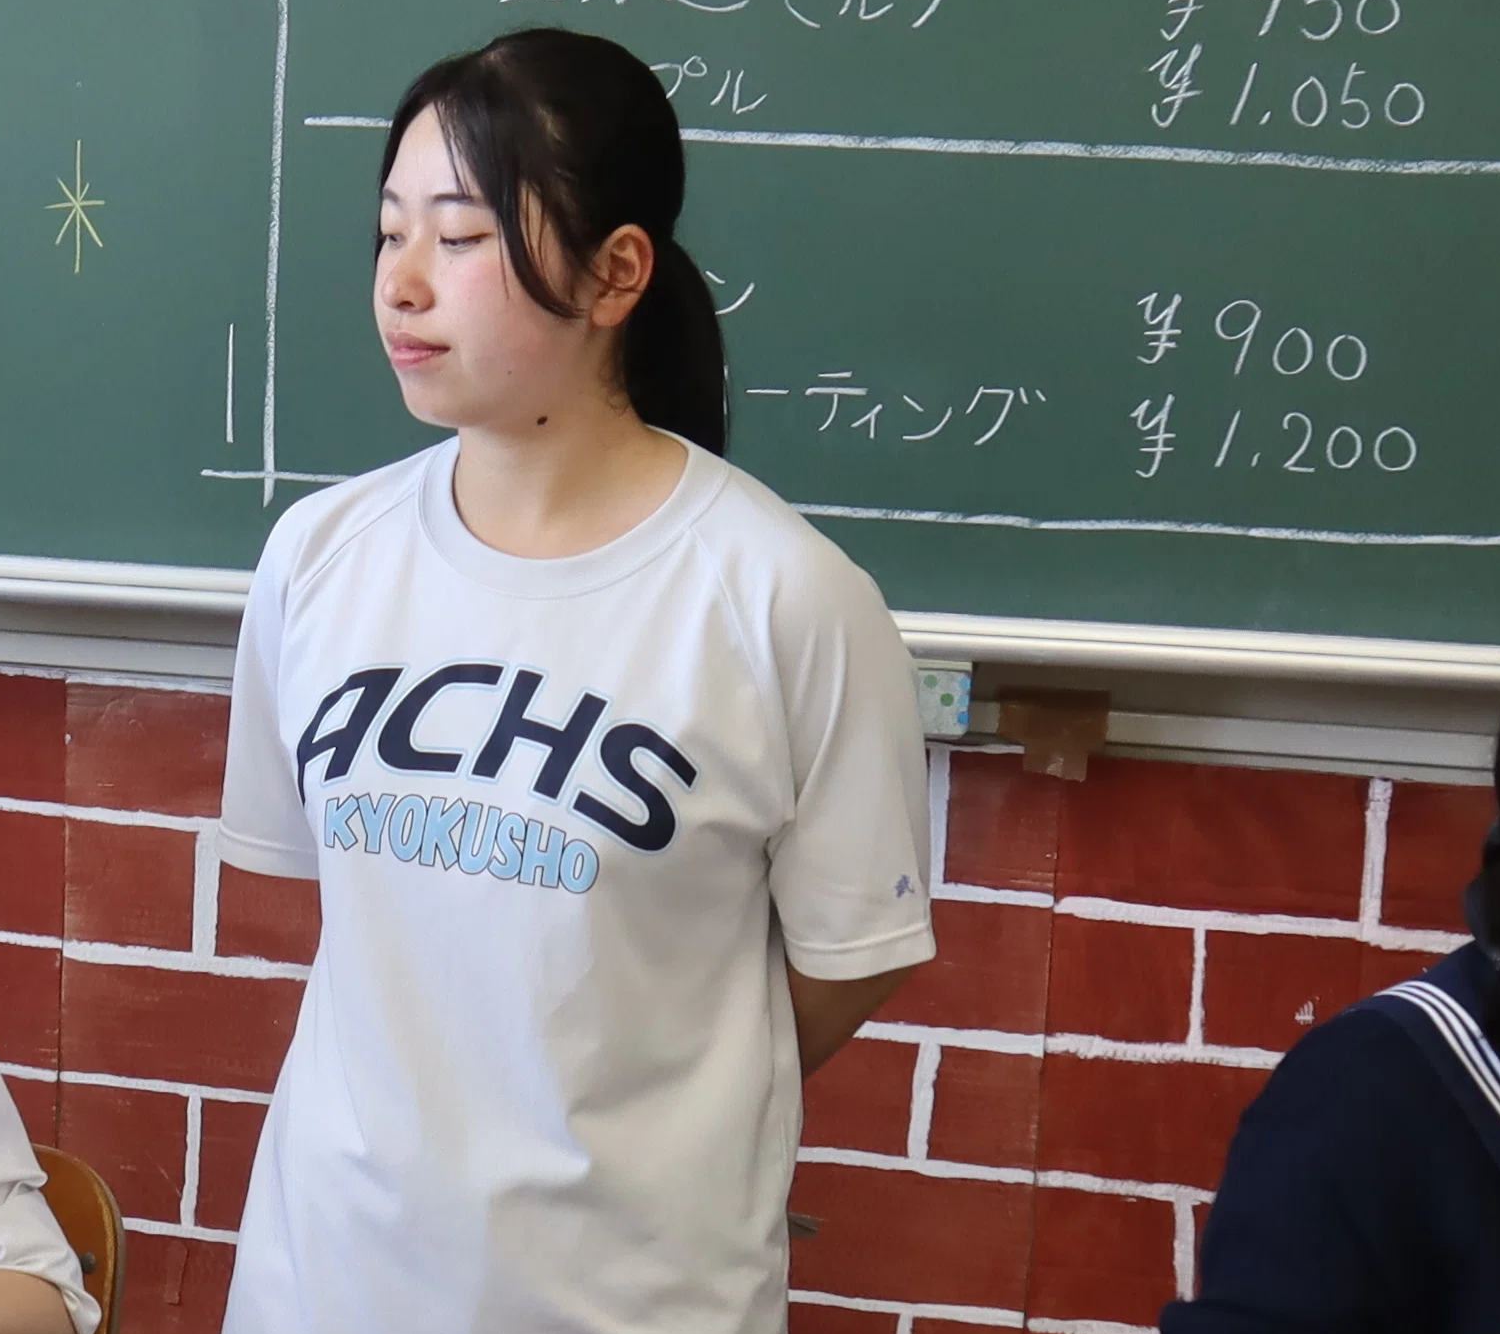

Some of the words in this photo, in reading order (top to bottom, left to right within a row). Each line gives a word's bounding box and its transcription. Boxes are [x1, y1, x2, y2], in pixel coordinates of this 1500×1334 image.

[1137, 292, 1367, 381] ¥900
[723, 366, 1046, 445] ーティング
[296, 662, 698, 852] ACHS
[324, 791, 600, 894] KYOKUSHO
